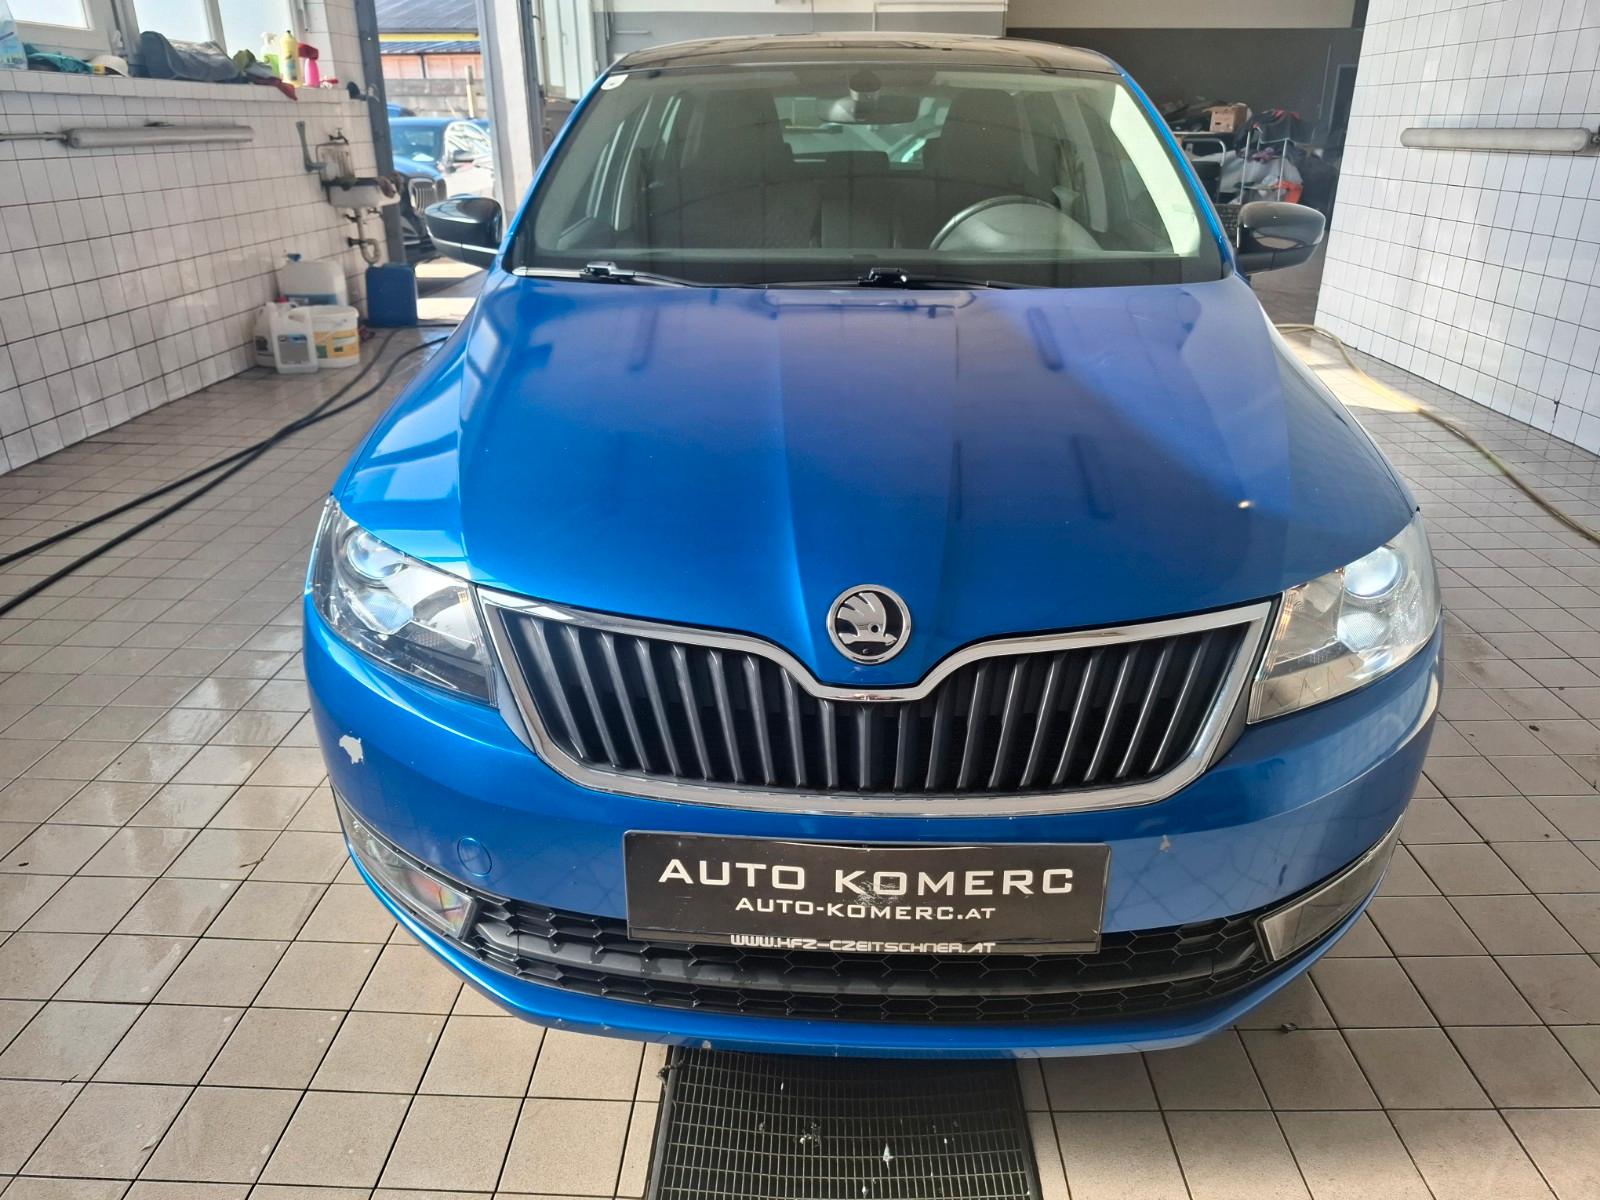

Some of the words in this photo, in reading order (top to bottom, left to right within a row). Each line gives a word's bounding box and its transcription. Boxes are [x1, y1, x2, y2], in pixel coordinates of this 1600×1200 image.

[658, 859, 805, 890] AUTO
[834, 869, 1074, 896] KOMERC
[735, 897, 996, 920] AUTO-KOMERC.AT
